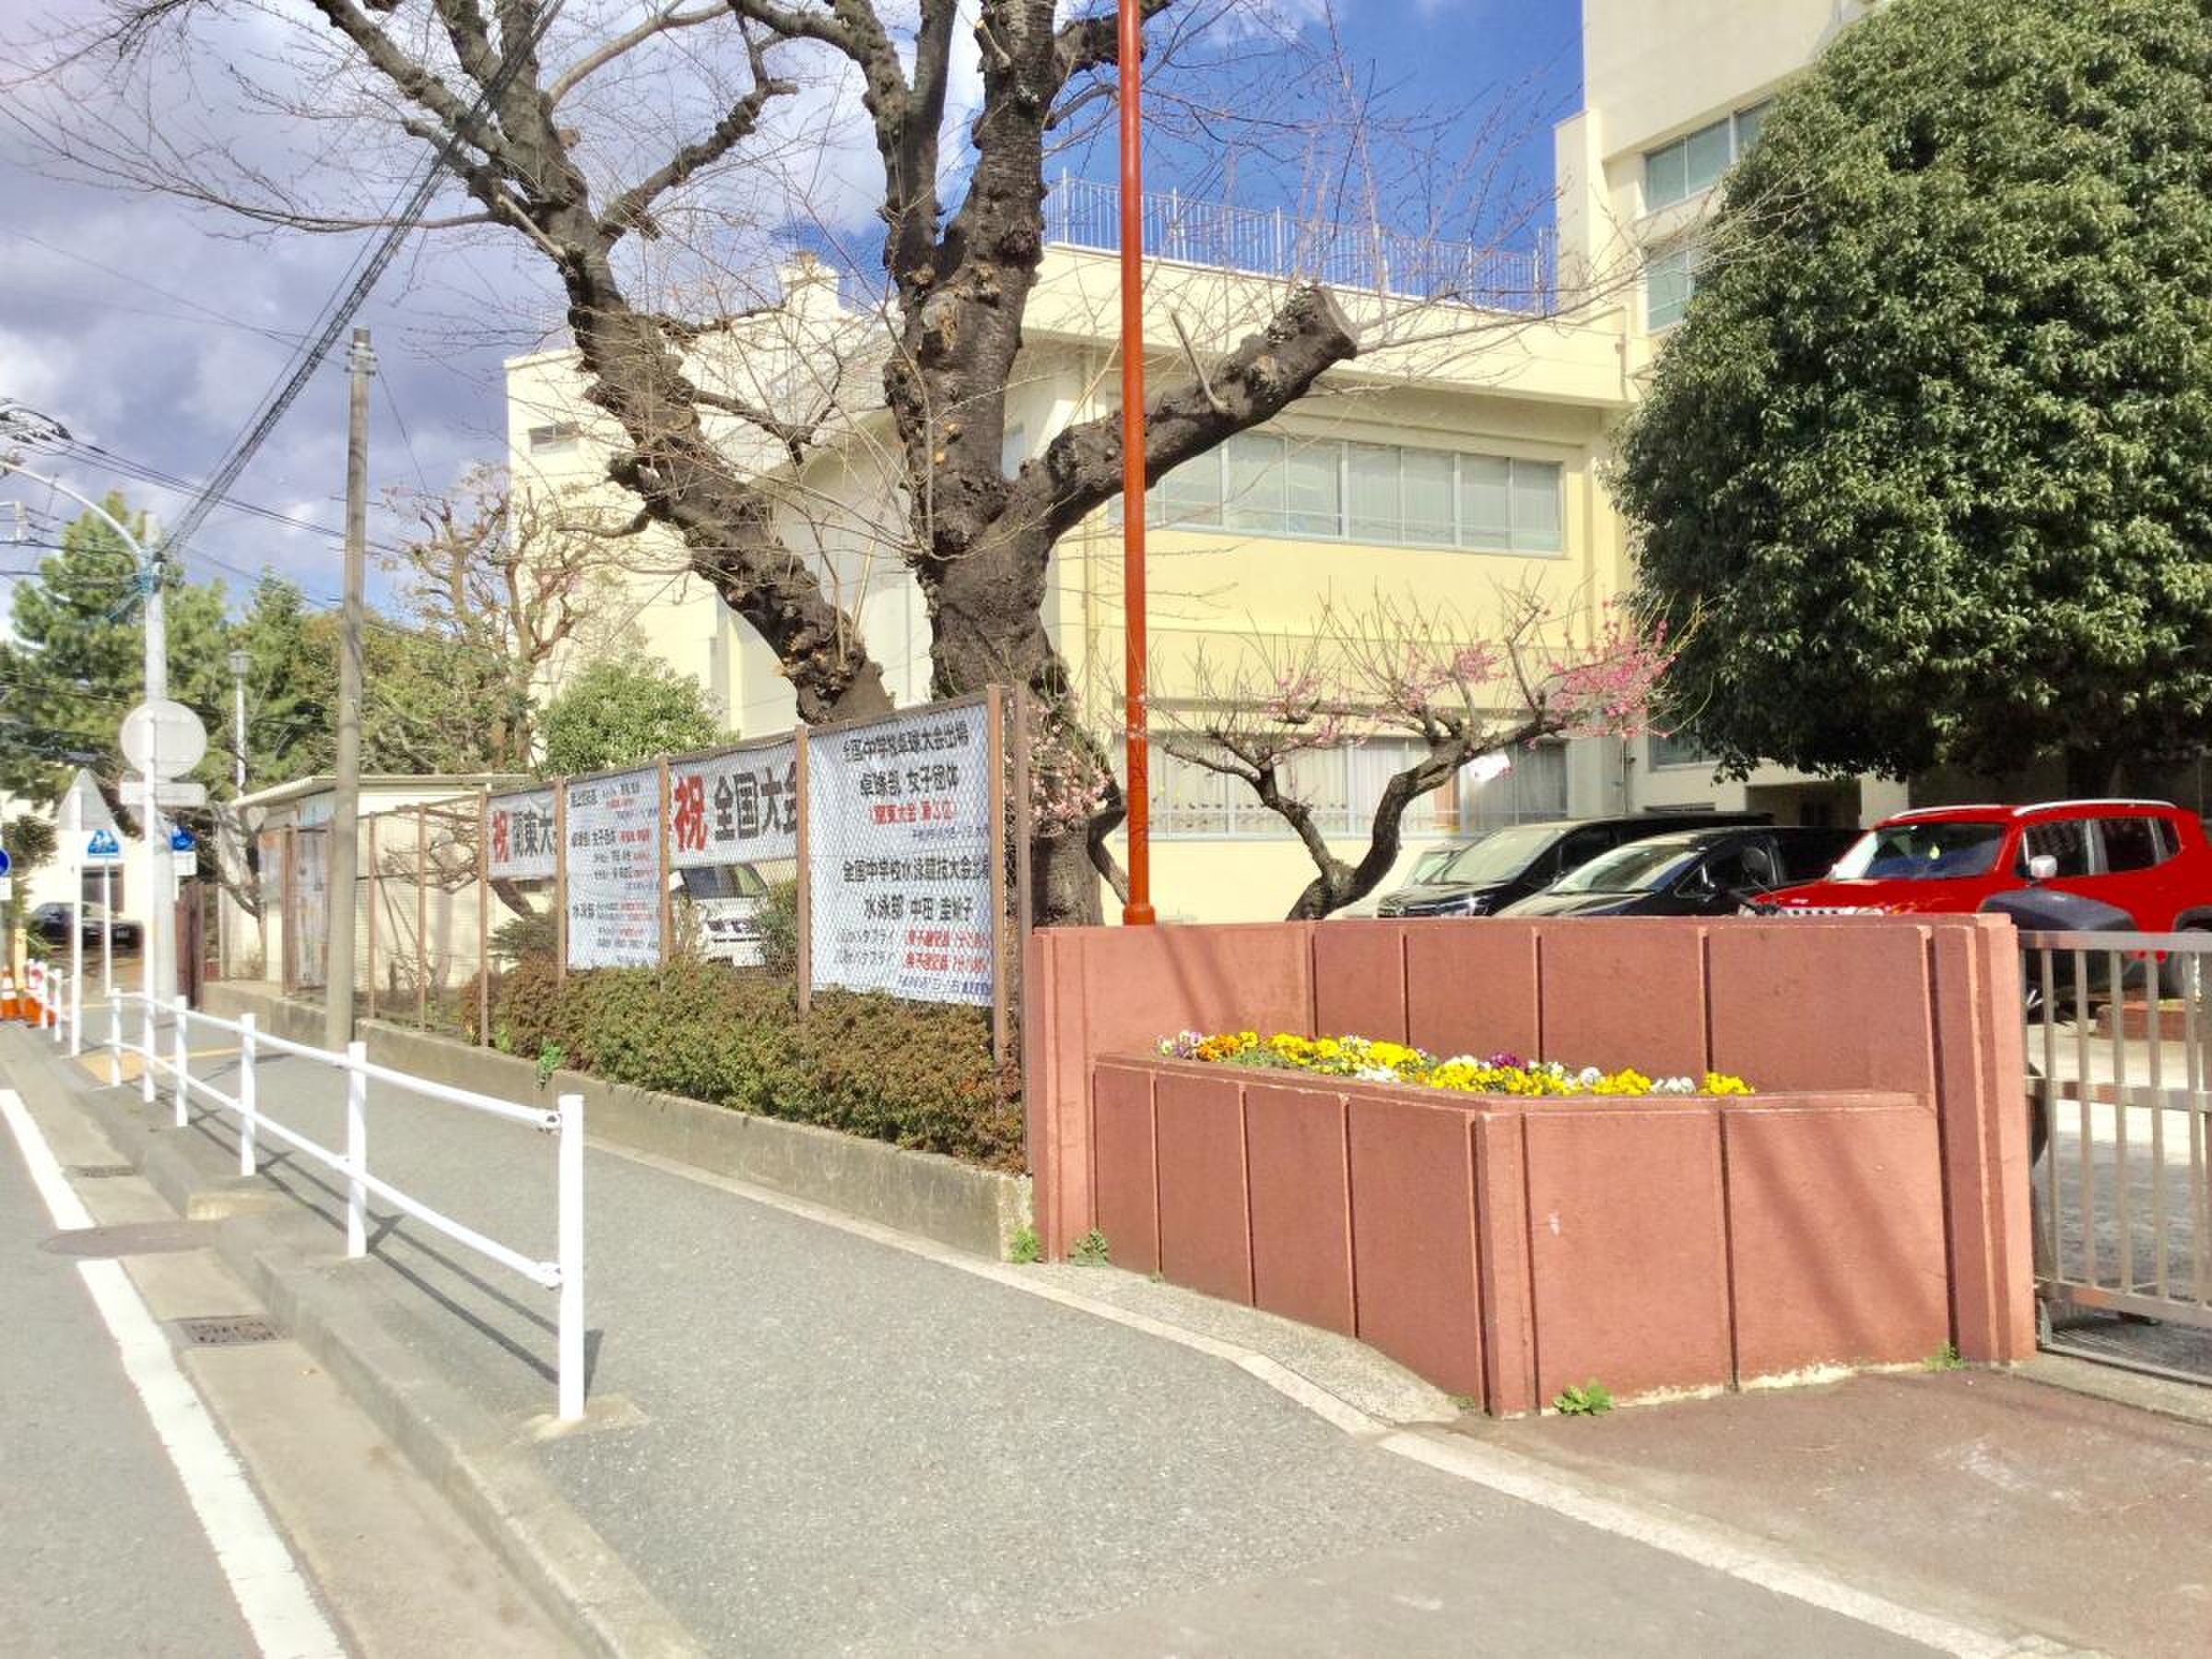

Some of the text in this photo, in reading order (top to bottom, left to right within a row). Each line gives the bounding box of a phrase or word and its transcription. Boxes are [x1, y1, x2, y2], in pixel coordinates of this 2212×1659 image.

[493, 806, 557, 863] 祝 関東大
[675, 773, 709, 852] 祝
